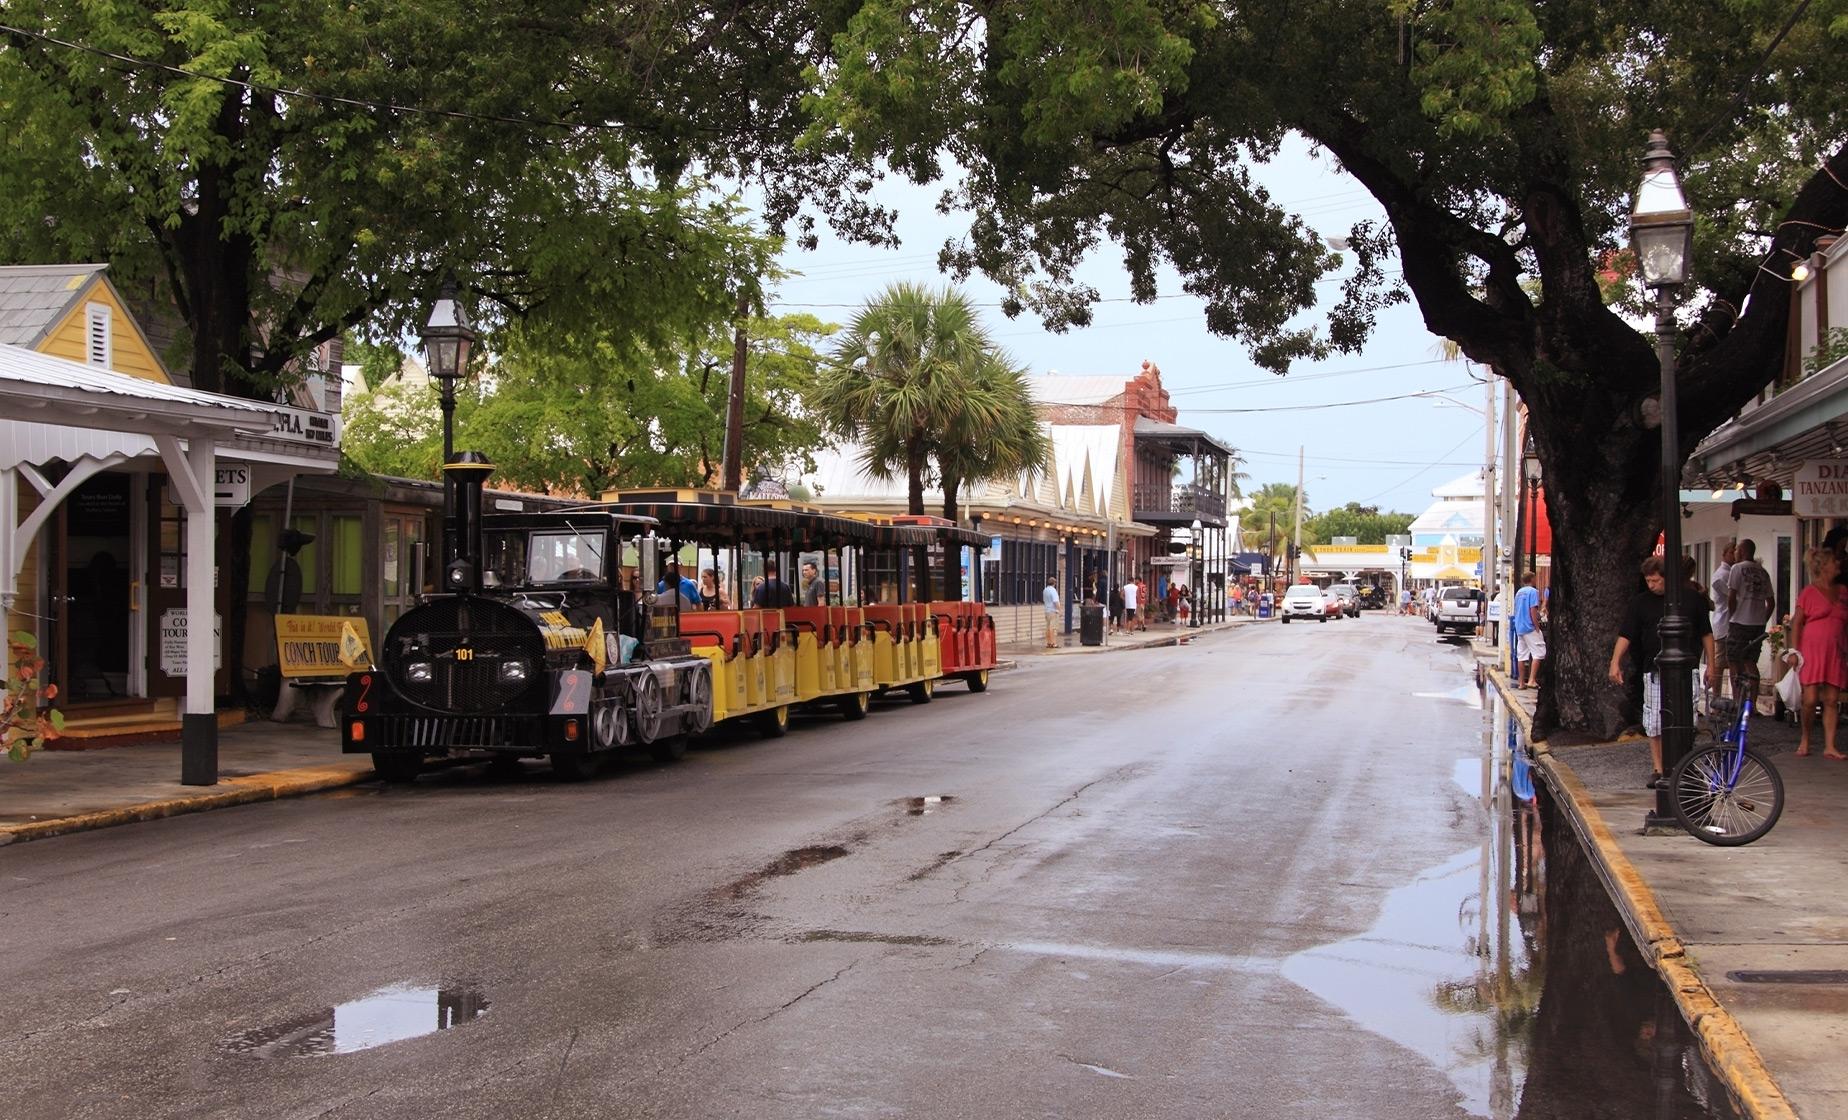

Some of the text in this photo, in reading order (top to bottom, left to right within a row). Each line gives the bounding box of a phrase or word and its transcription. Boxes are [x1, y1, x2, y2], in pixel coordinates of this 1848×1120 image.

[215, 469, 246, 484] ETS
[1818, 464, 1848, 479] DIA
[1799, 481, 1848, 495] TANZANI
[173, 618, 187, 627] CO
[163, 629, 187, 638] TOUR
[285, 641, 315, 665] CONCH
[455, 649, 473, 660] 101
